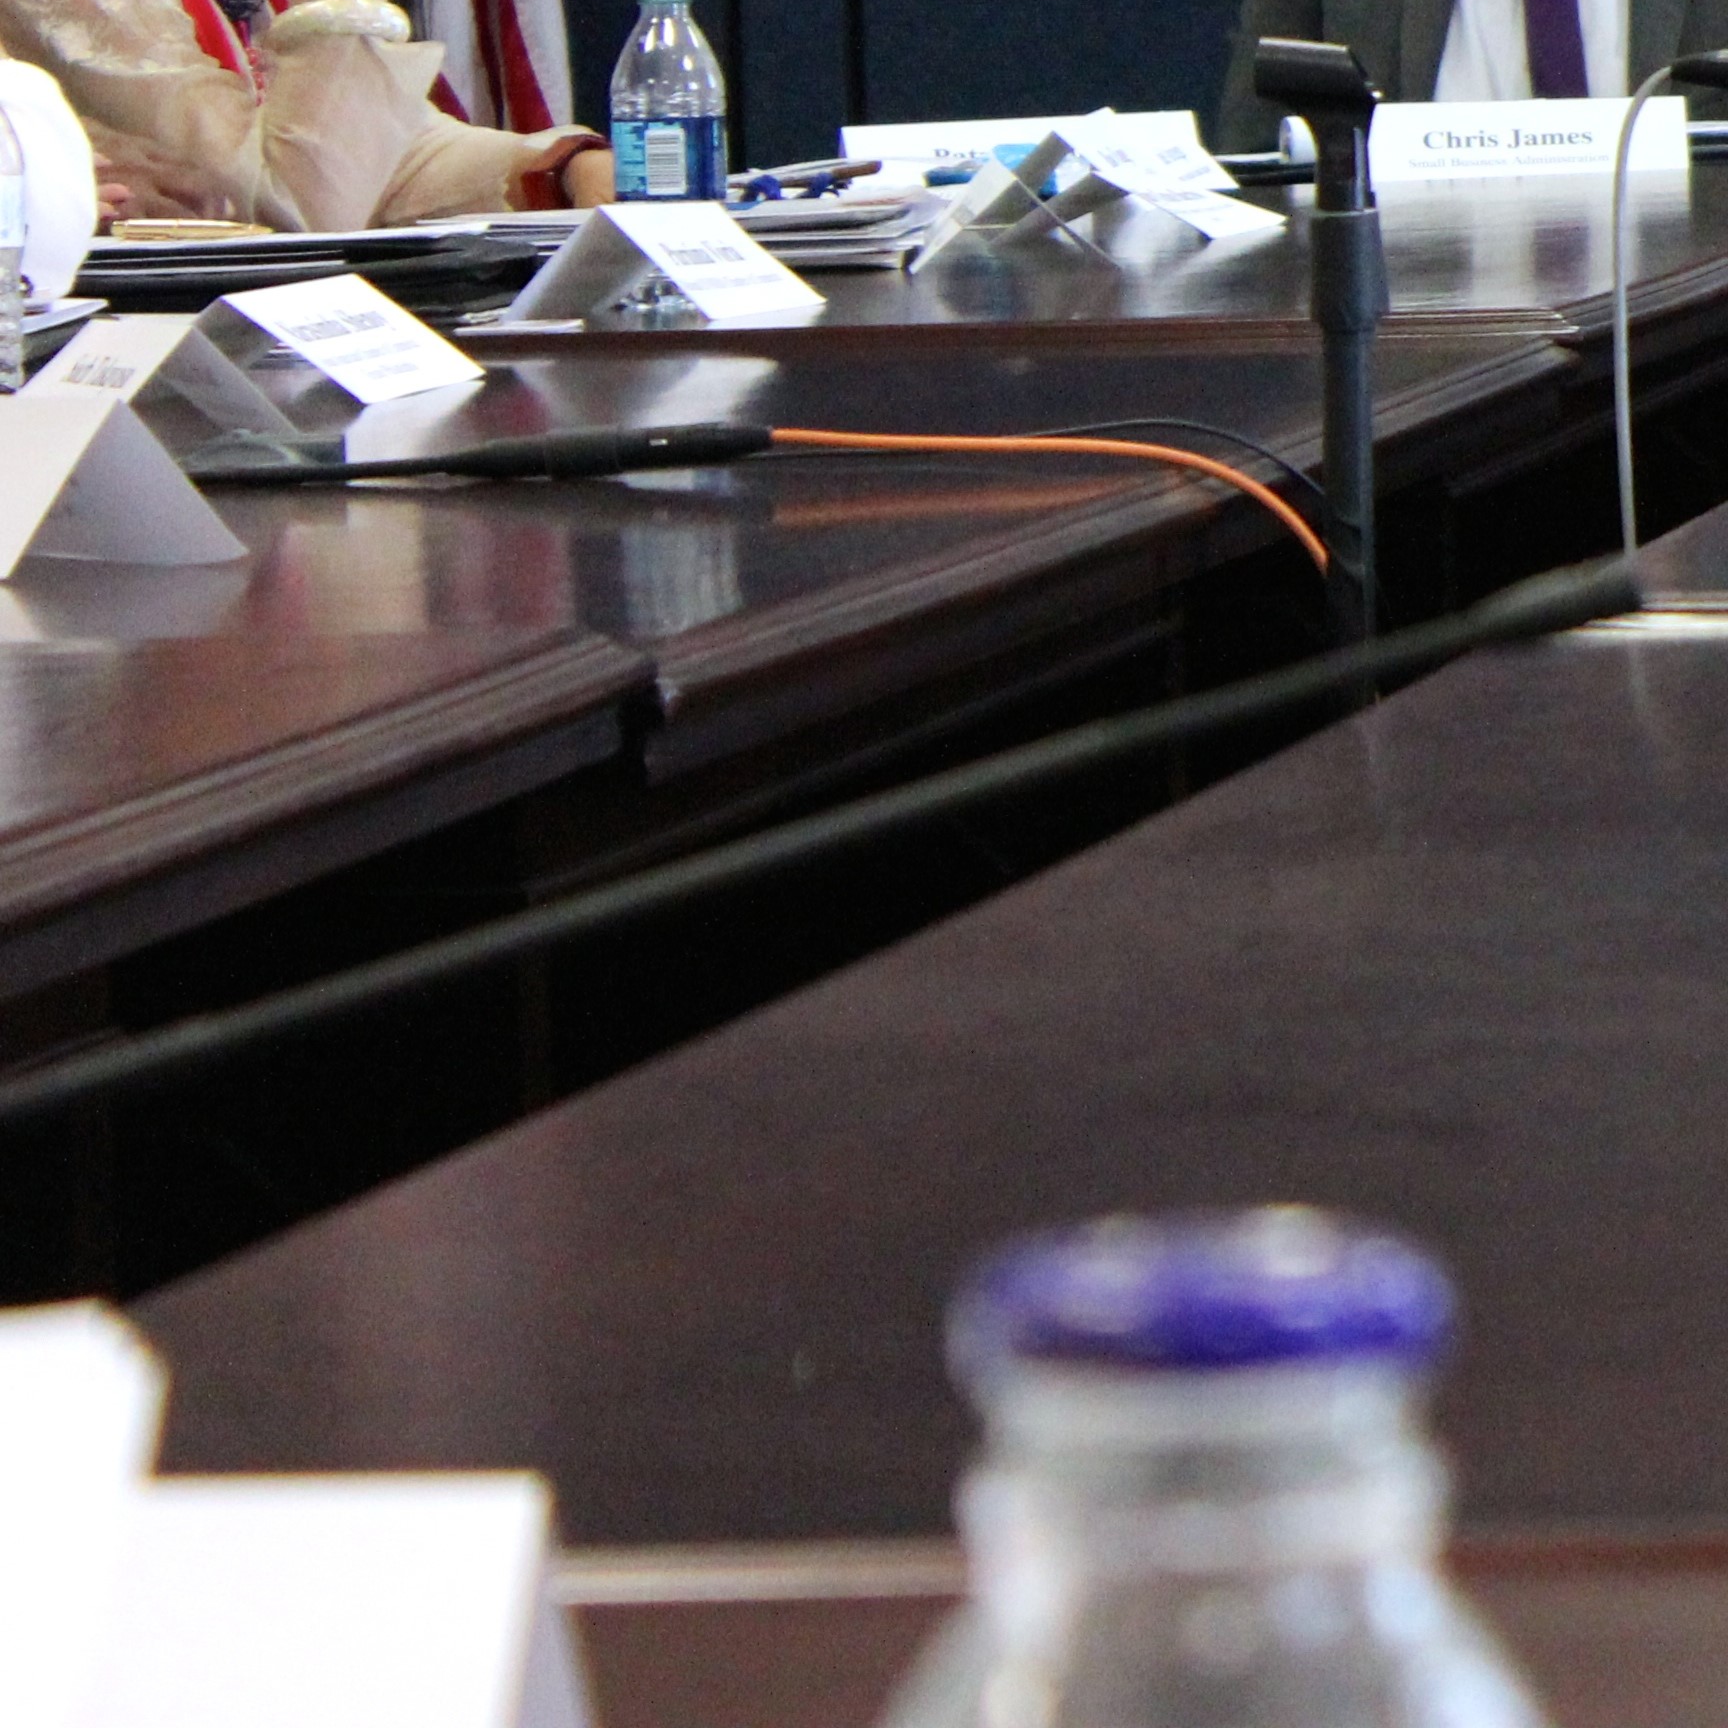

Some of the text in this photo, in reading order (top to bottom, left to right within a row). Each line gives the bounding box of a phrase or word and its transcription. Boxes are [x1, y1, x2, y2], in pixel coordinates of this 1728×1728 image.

[1423, 127, 1594, 150] Chris James
[1408, 158, 1446, 169] Small
